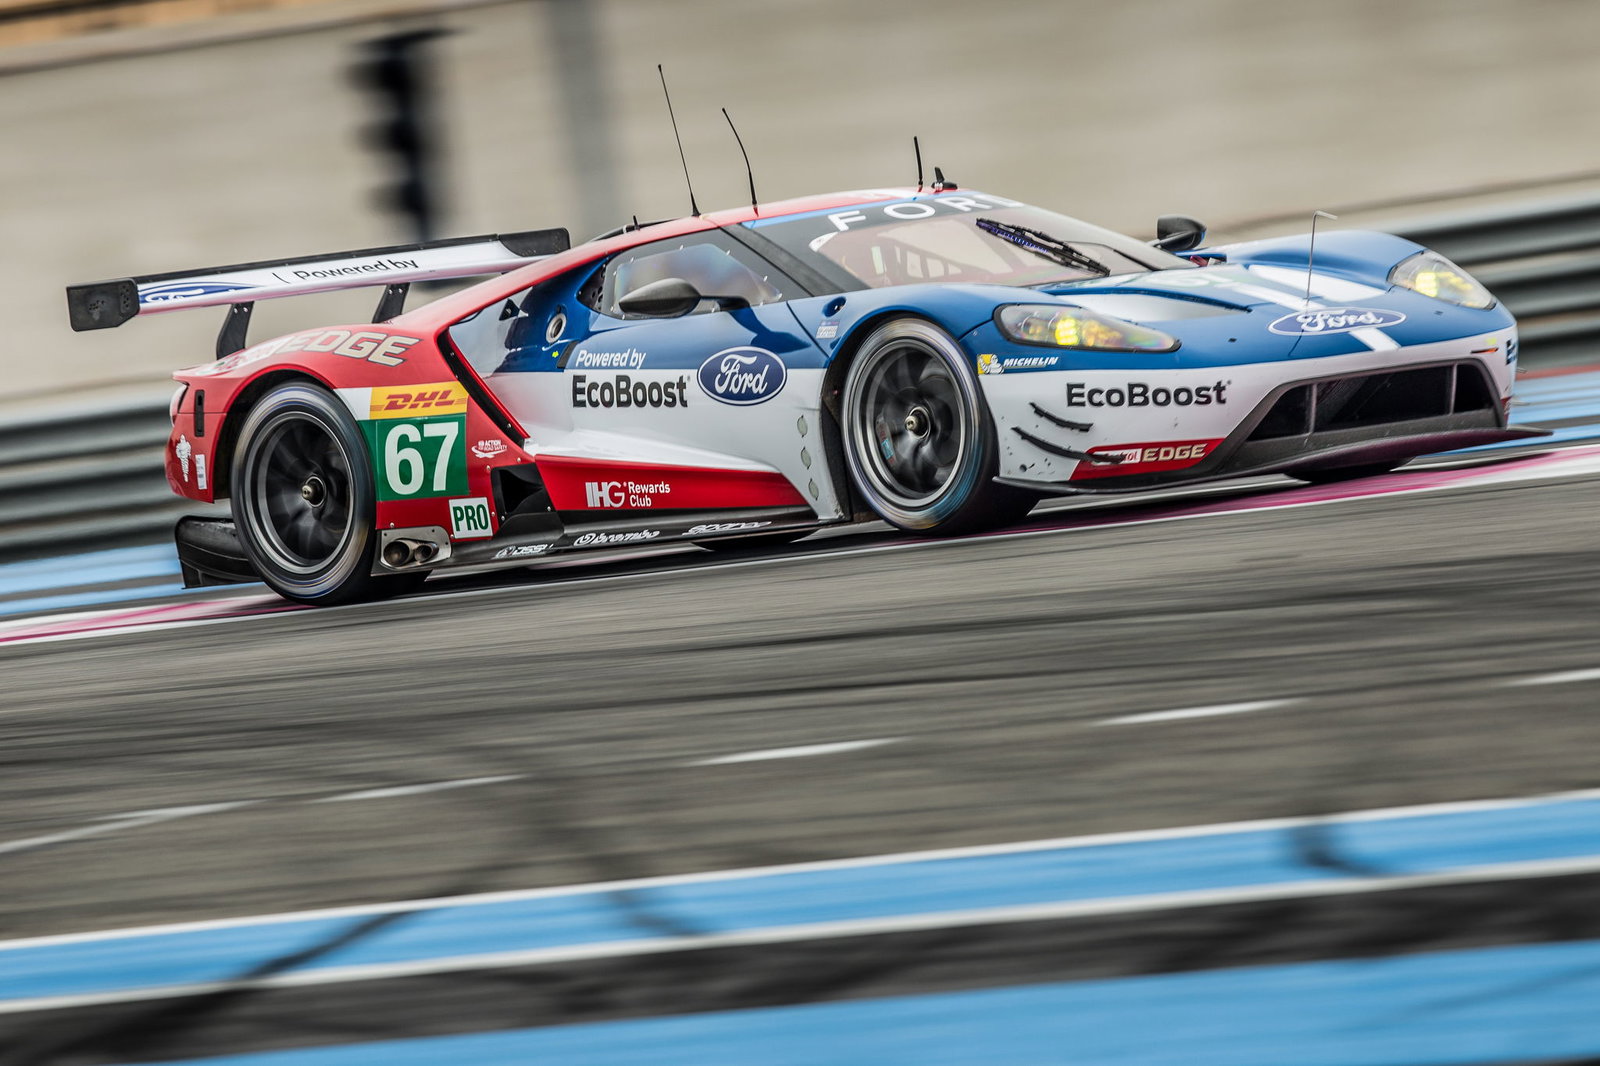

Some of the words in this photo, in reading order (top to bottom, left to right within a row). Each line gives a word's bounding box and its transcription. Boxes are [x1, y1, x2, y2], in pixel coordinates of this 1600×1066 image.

[293, 260, 390, 280] Powered
[387, 258, 420, 270] by
[1295, 309, 1384, 333] Ford
[274, 330, 423, 367] EDGE
[575, 349, 628, 368] Powered
[629, 349, 647, 369] by
[713, 353, 770, 395] Ford
[1003, 356, 1059, 368] MICHELIN
[384, 390, 456, 411] DHL
[572, 375, 689, 408] EcoBoost
[1066, 380, 1229, 408] EcoBoost
[385, 421, 459, 495] 67
[1142, 443, 1208, 463] EDGE
[585, 481, 625, 508] IHG
[628, 481, 671, 494] Rewards
[629, 494, 652, 508] Club
[452, 503, 490, 532] PRO
